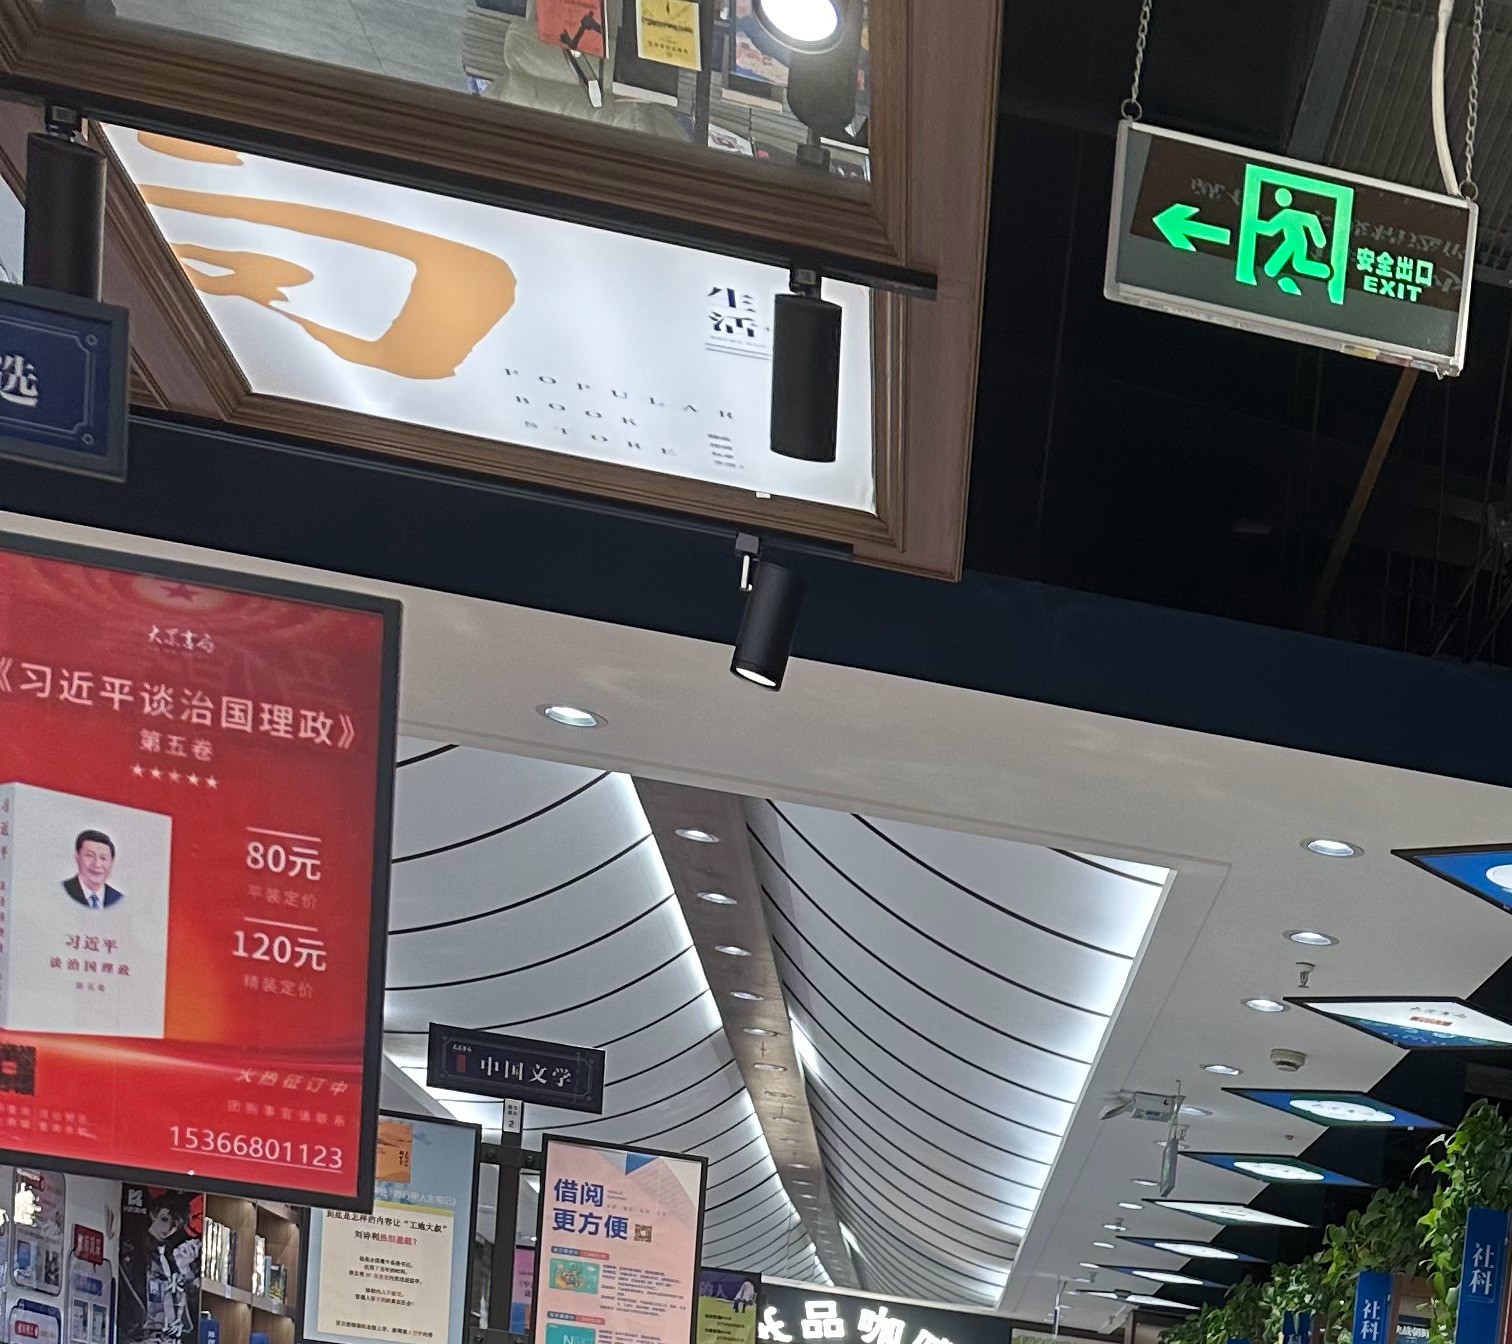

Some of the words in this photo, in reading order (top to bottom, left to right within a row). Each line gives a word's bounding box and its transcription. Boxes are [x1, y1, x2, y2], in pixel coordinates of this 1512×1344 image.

[1356, 247, 1434, 287] 安全出口
[1363, 275, 1422, 302] EXIT
[0, 656, 356, 750] 《习近平谈治国理政》
[138, 729, 214, 761] 第五卷
[245, 838, 322, 882] 80元
[63, 933, 119, 955] 习近平
[232, 928, 328, 972] 120元
[479, 1056, 572, 1088] 中国文学
[169, 1126, 344, 1170] 15366801123
[553, 1178, 605, 1208] 借阅
[552, 1207, 629, 1240] 更方便
[1467, 1242, 1496, 1296] 社科
[1359, 1298, 1381, 1342] 社科
